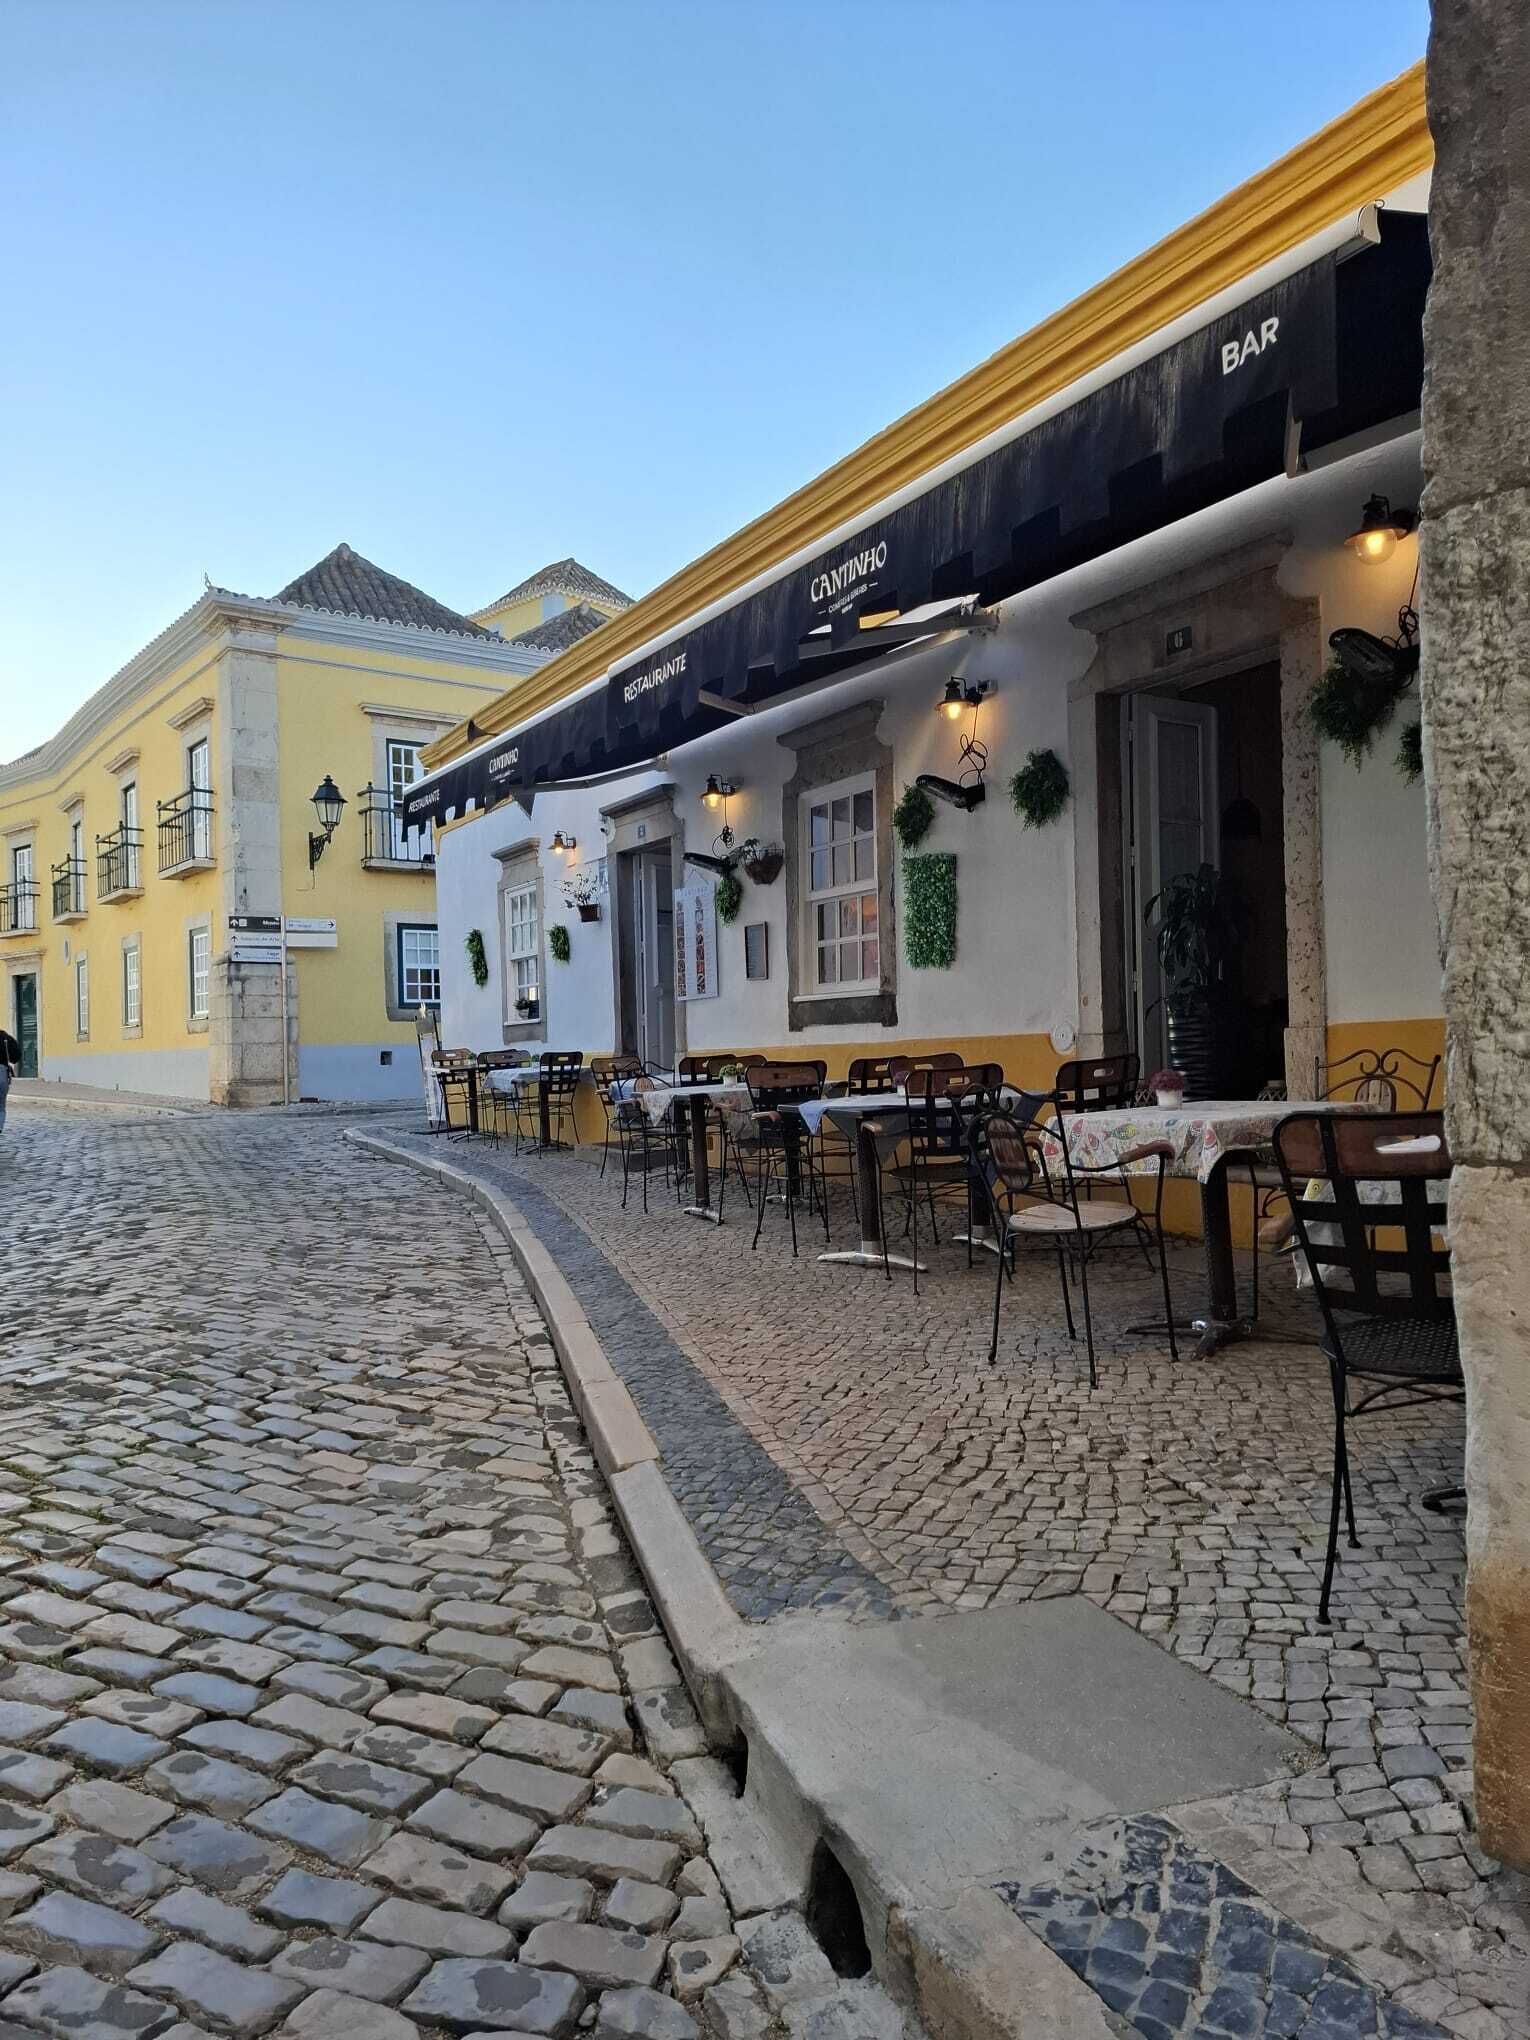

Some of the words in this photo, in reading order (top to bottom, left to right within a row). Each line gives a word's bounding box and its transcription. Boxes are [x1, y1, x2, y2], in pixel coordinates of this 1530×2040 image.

[1221, 316, 1280, 375] BAR
[810, 540, 887, 602] CANTINHO
[623, 652, 687, 703] RESTAURANTE
[488, 746, 519, 774] CANTINHO
[408, 788, 440, 813] RESTAURANTE
